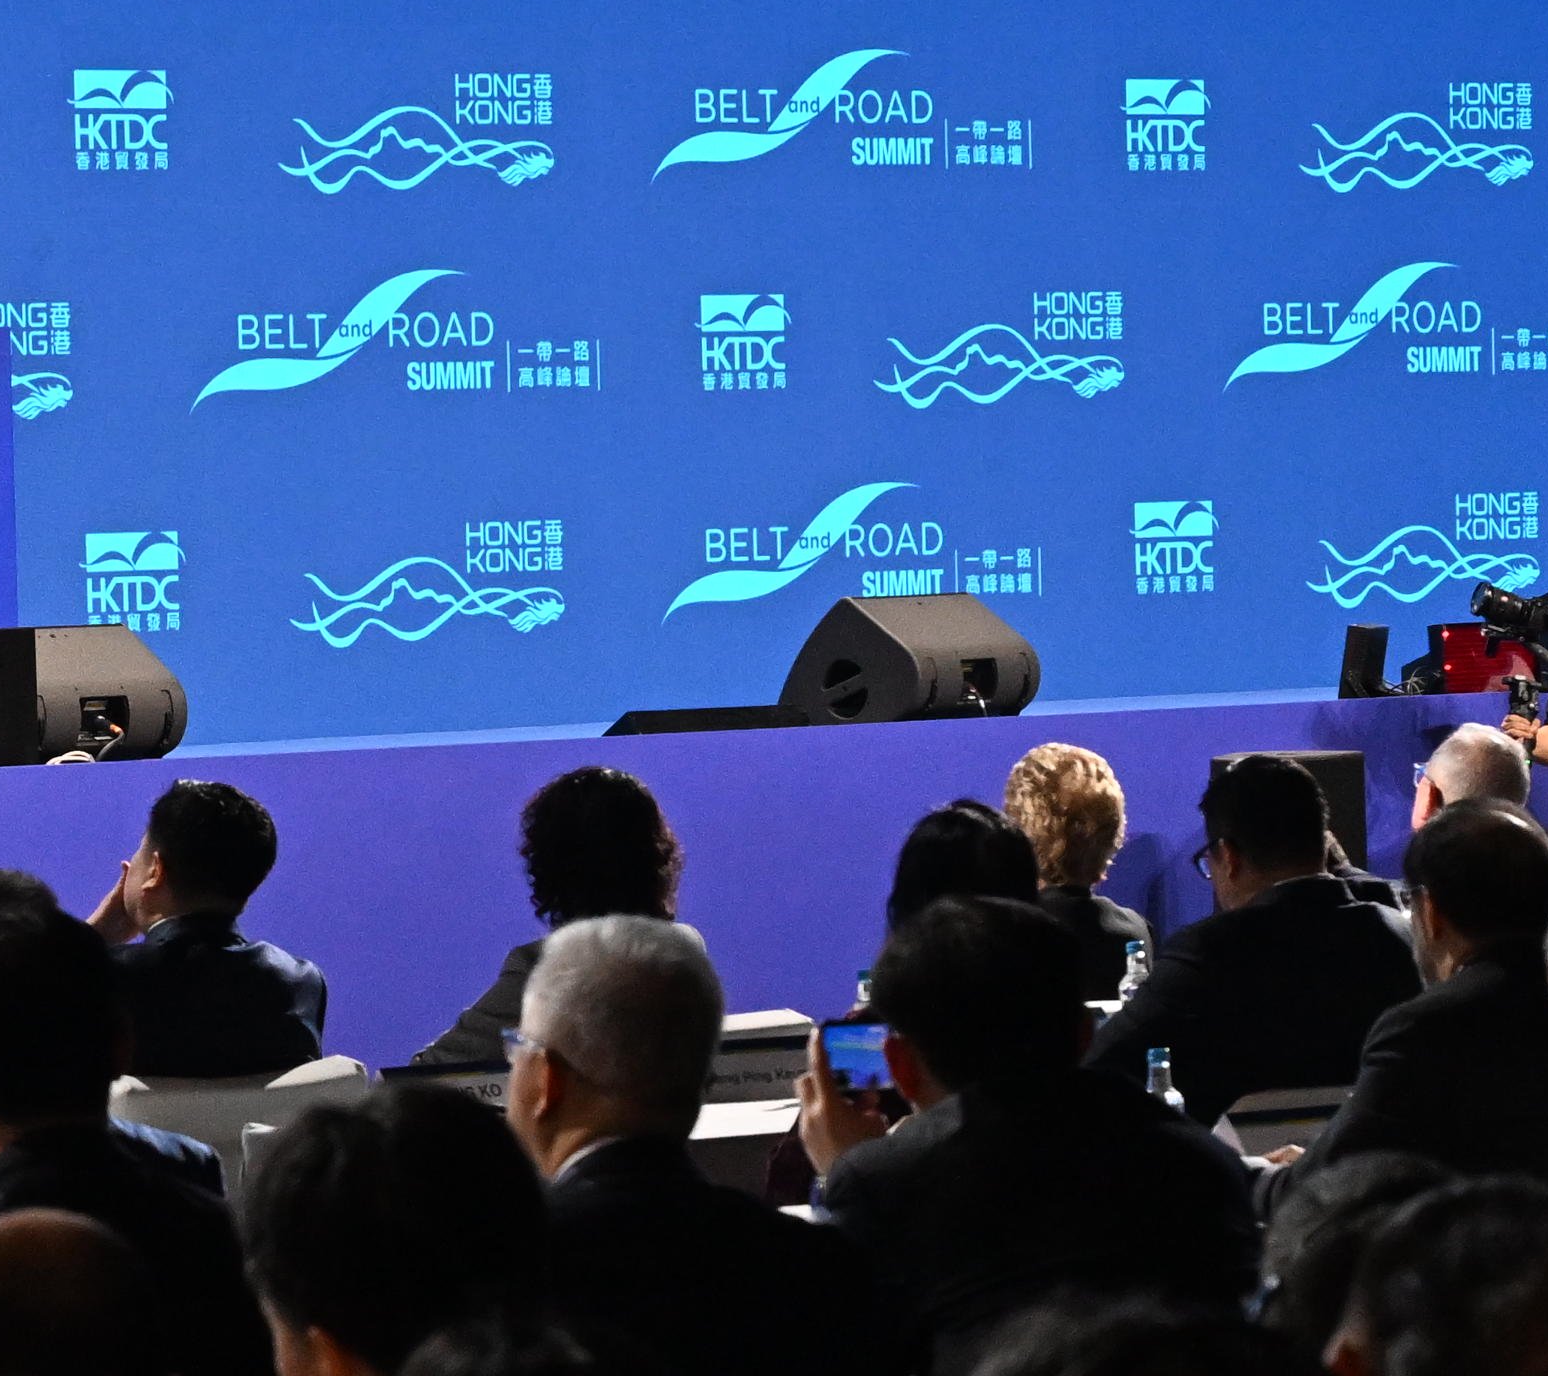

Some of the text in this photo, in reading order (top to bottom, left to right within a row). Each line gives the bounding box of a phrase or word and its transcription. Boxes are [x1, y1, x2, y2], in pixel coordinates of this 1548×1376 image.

[237, 311, 494, 351] BELT and ROAD
[518, 341, 589, 361] 一帶一路
[407, 361, 494, 390] SUMMIT
[519, 366, 590, 387] 高峰論壇
